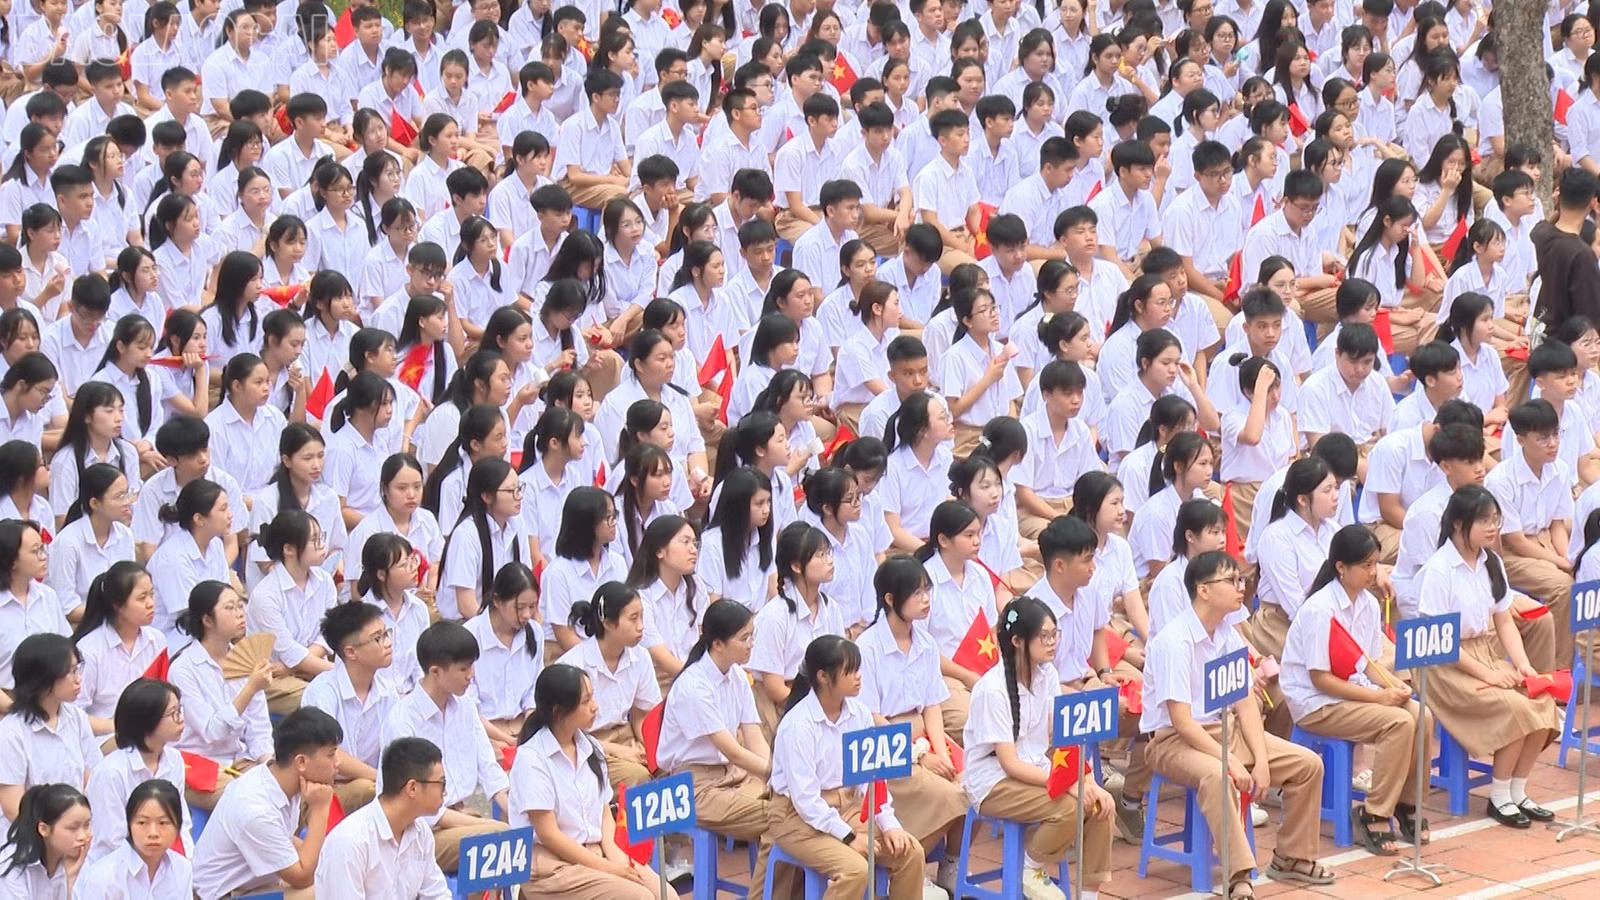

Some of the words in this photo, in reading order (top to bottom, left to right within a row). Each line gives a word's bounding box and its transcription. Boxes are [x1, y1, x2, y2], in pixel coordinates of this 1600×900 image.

[1403, 621, 1454, 659] 10A8
[1208, 657, 1245, 700] 10A9
[1059, 697, 1113, 738] 12A1
[848, 732, 908, 774] 12A2
[630, 783, 692, 831] 12A3
[466, 837, 528, 881] 12A4
